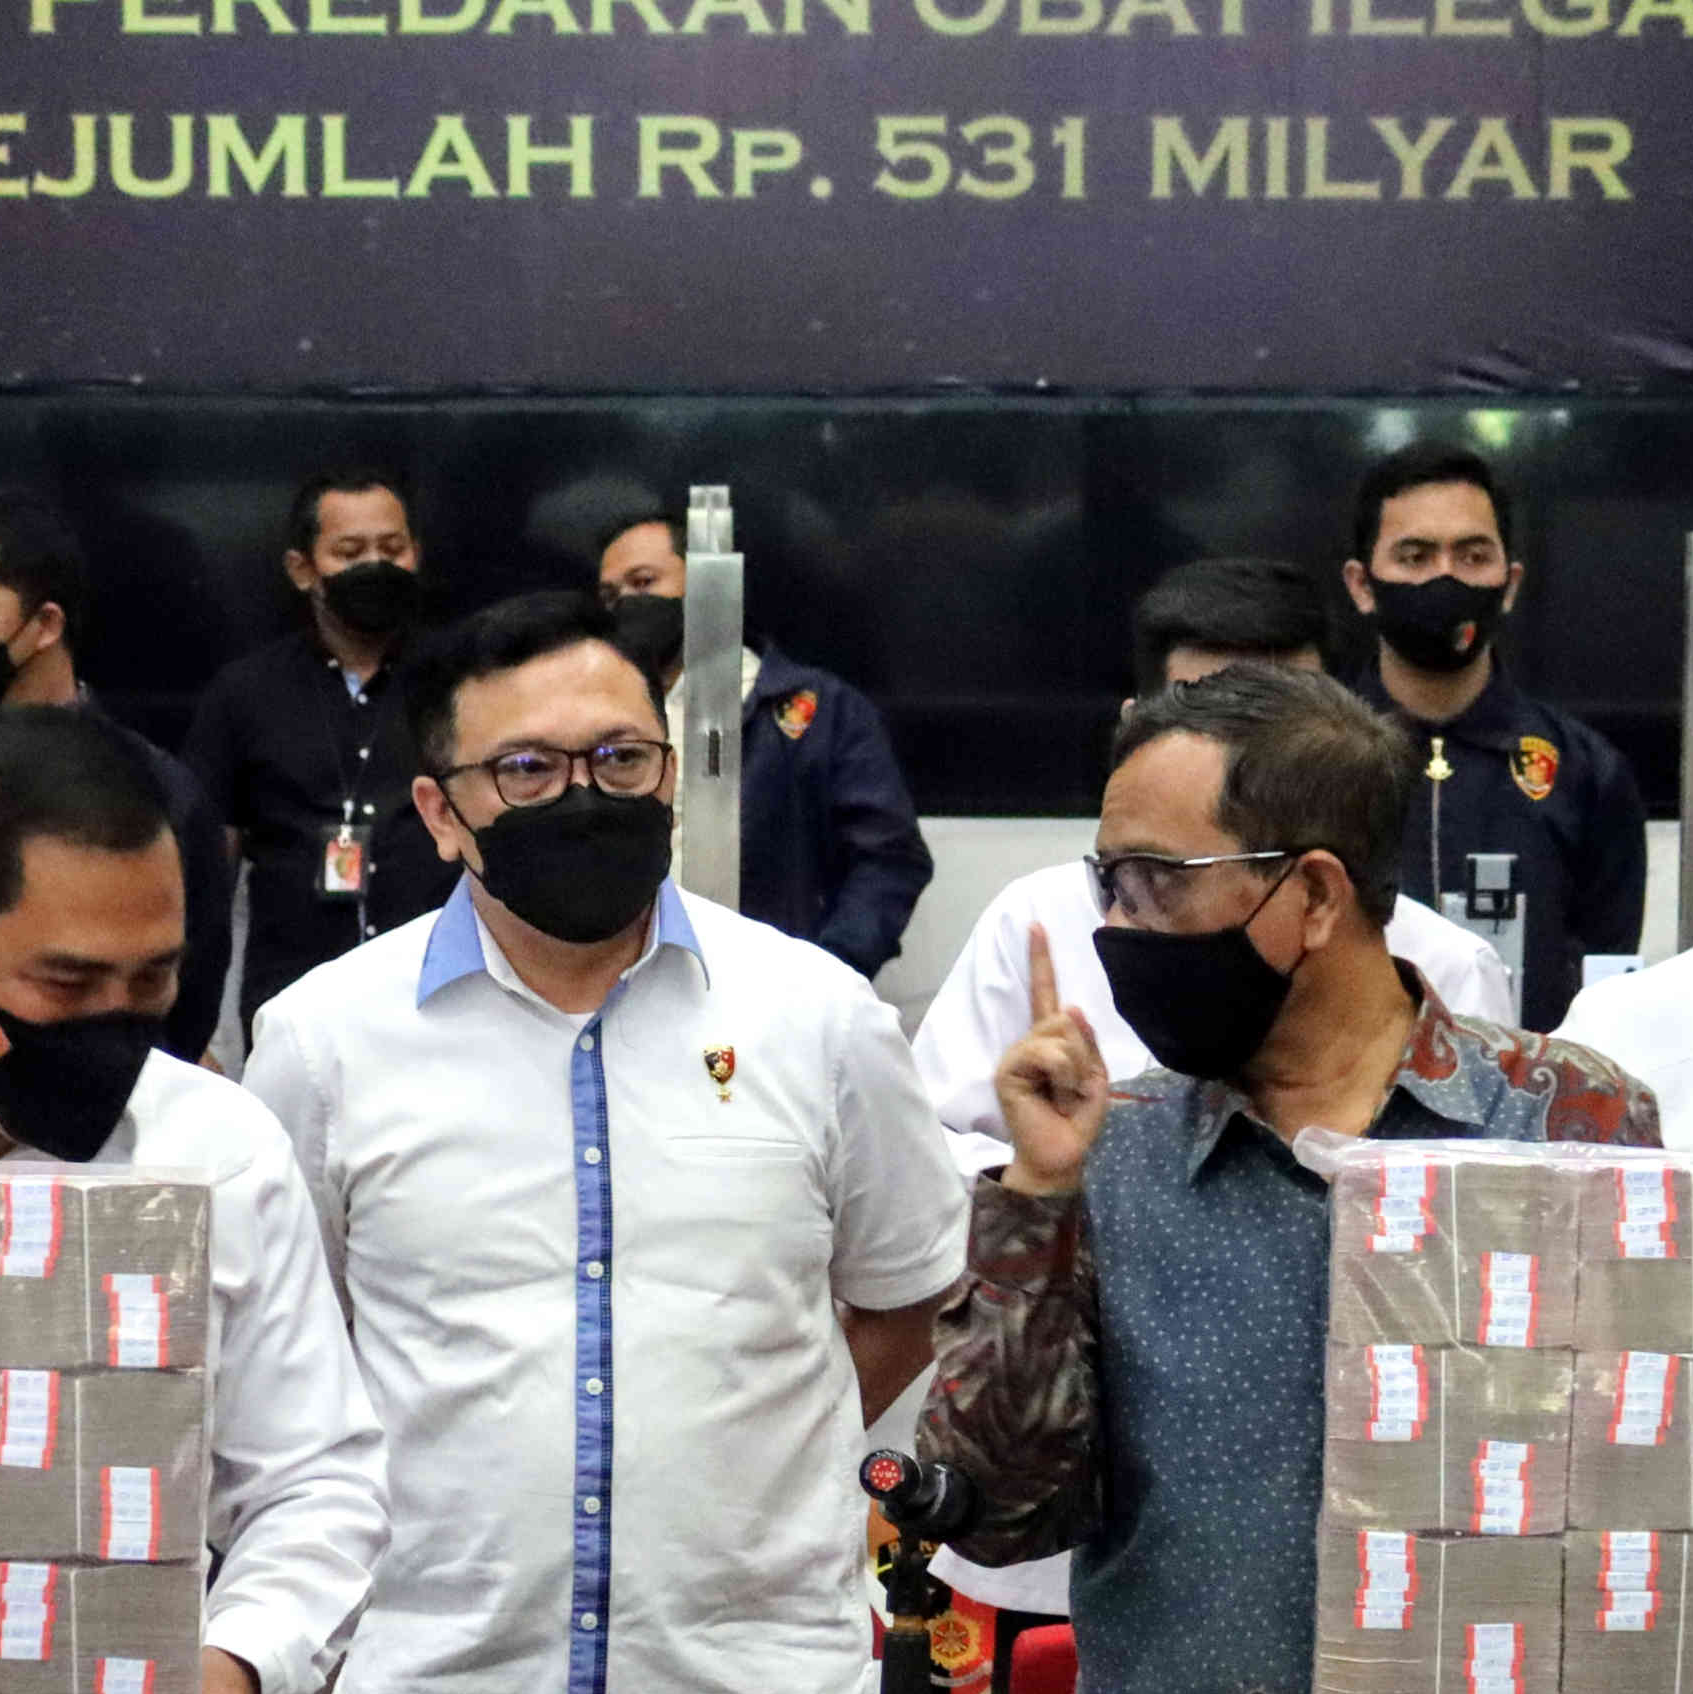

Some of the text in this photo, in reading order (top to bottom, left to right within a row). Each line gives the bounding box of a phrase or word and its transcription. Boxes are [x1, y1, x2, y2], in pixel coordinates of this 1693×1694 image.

[635, 112, 834, 201] Rp.
[872, 112, 1088, 201] 531
[1148, 113, 1633, 200] MILYAR
